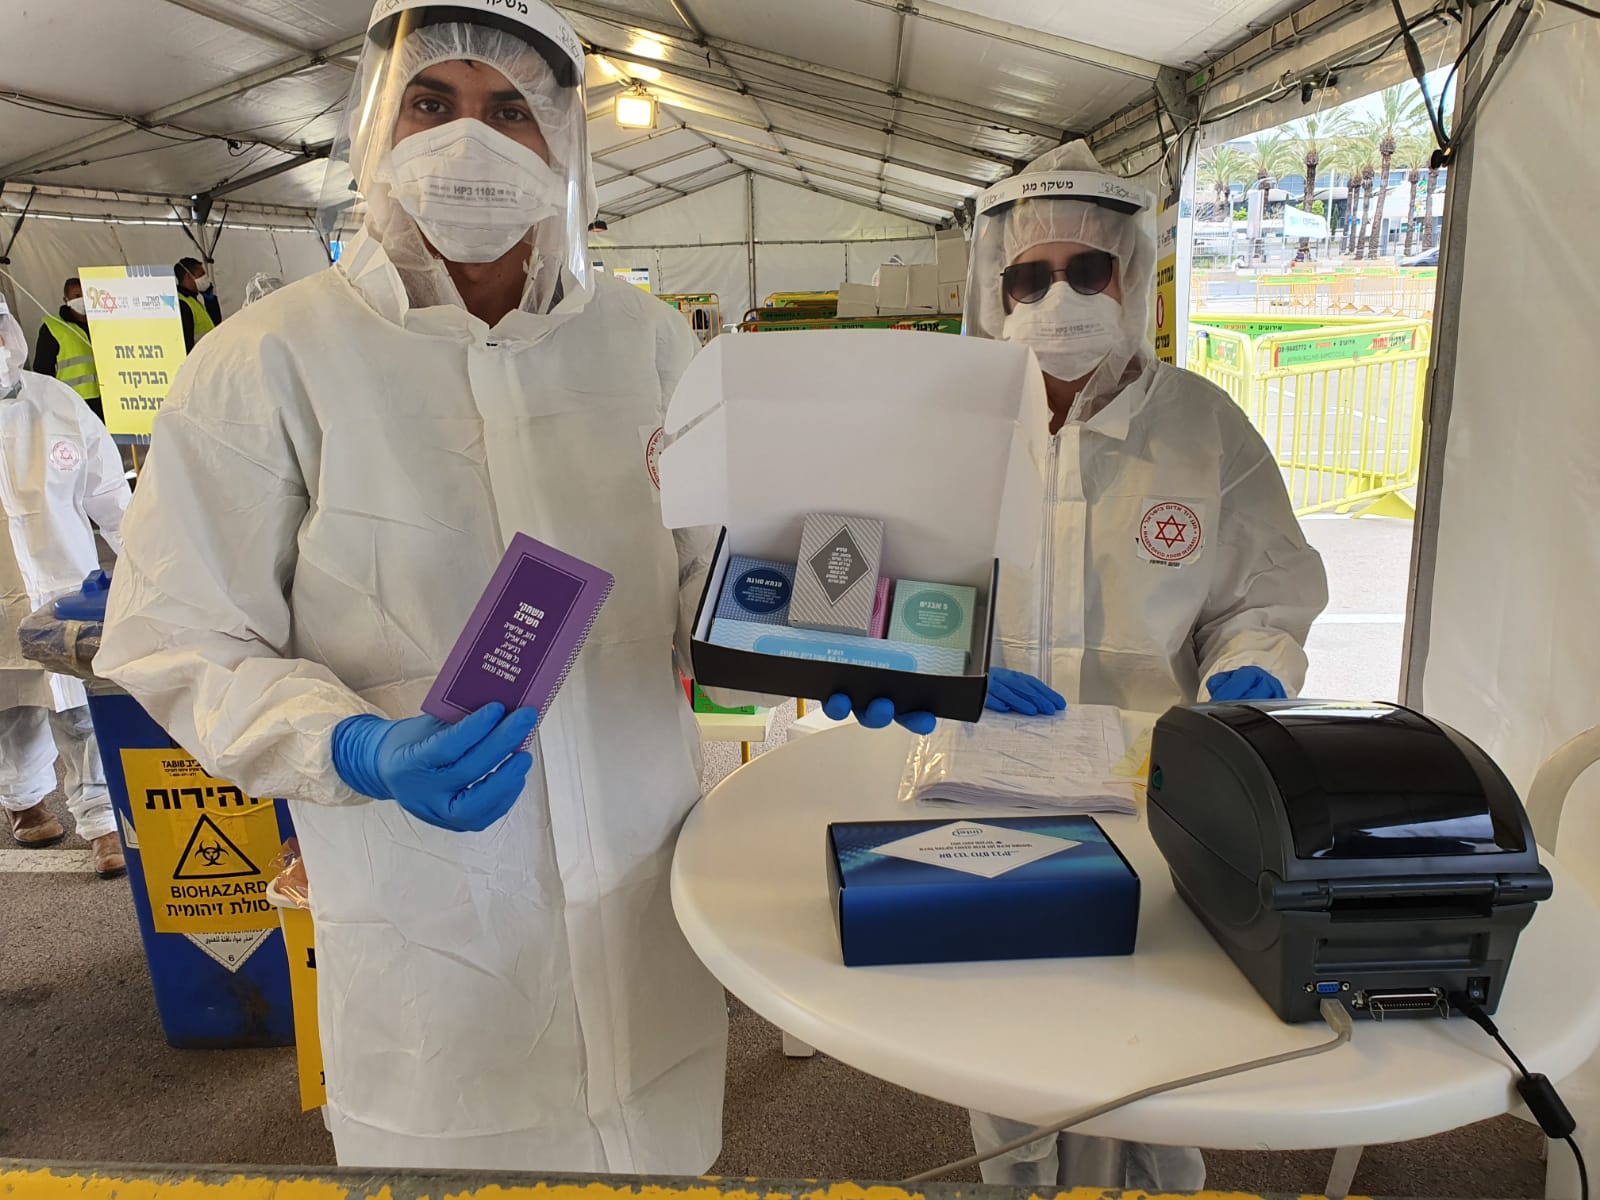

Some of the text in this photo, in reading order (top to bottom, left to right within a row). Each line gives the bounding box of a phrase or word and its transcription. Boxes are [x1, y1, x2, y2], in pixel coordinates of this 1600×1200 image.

[1022, 181, 1074, 194] משקף מגן
[115, 345, 164, 359] הצג את
[118, 371, 169, 389] הברקוד
[513, 610, 540, 628] חשיבה
[519, 601, 545, 620] משחקי
[161, 760, 185, 768] TABIB
[145, 785, 259, 810] הירות
[171, 880, 268, 899] BIOHAZARD
[166, 897, 278, 917] סולת זיהומית
